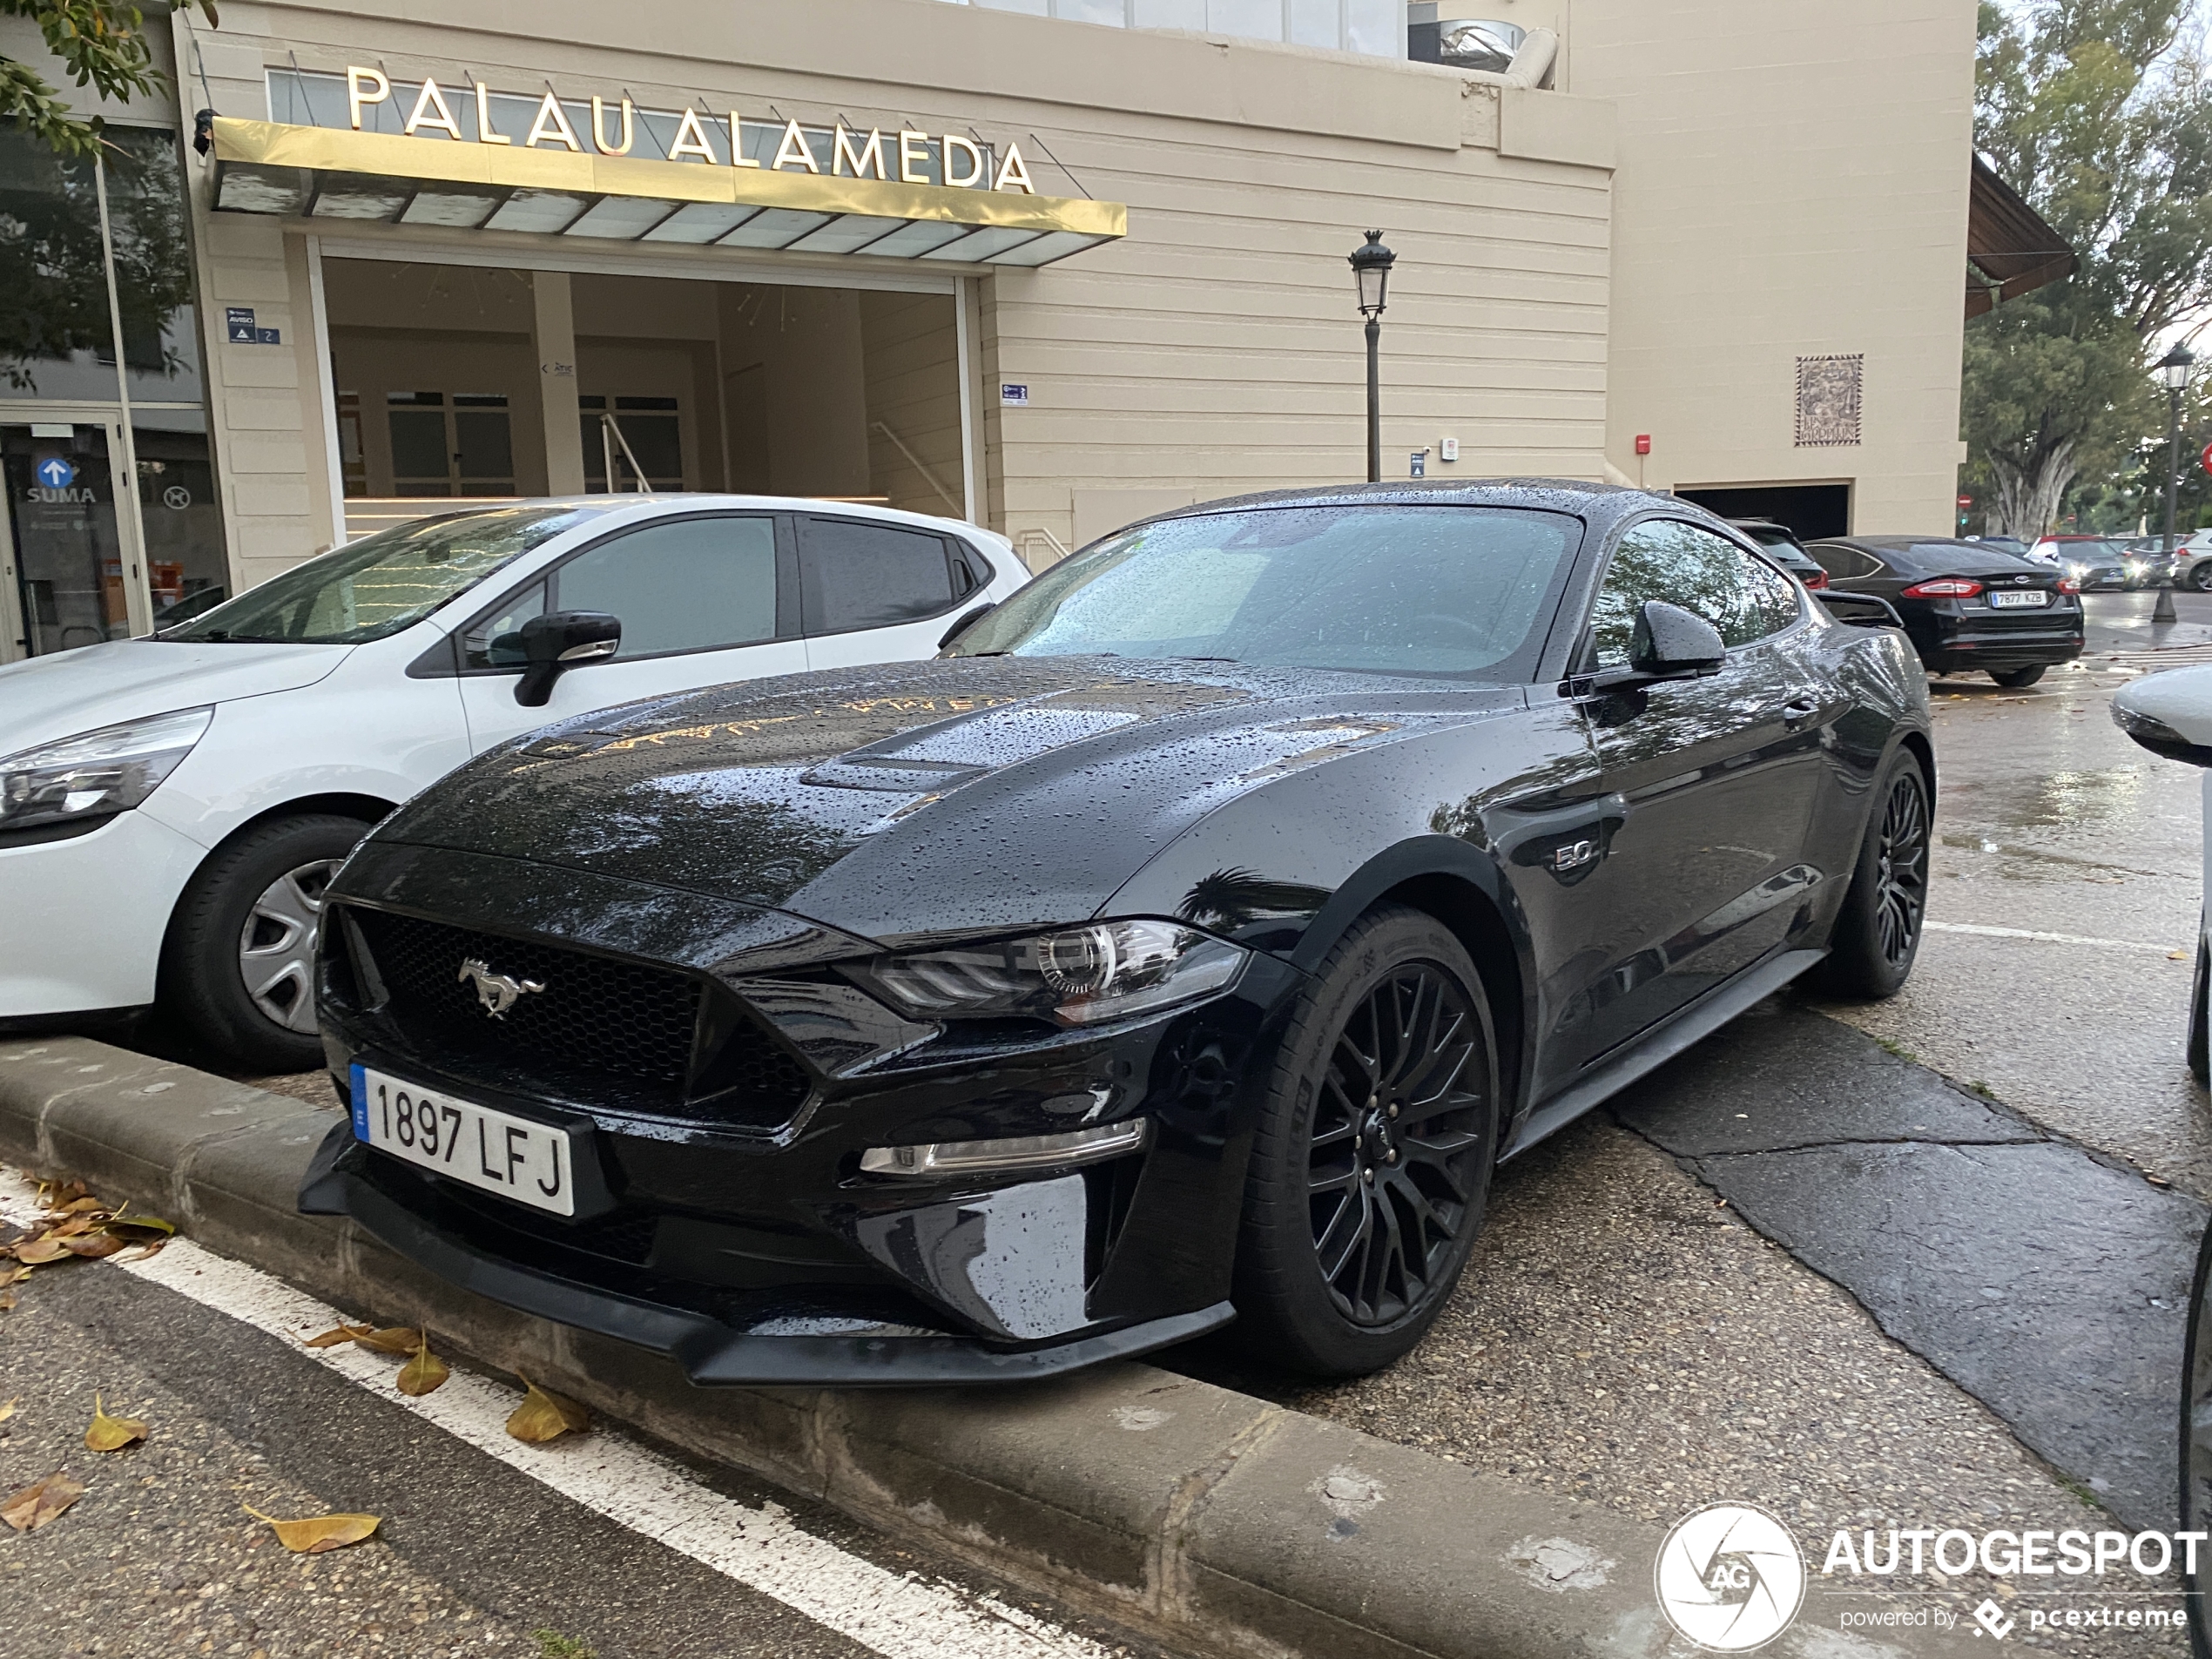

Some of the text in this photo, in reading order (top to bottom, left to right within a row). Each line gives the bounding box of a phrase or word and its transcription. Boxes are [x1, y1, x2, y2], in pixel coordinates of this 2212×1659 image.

[347, 65, 1035, 193] PALAU ALAMEDA
[265, 331, 273, 341] 2
[27, 488, 96, 503] SUMA
[1999, 592, 2041, 604] 7877 KZB
[378, 1084, 560, 1197] 1897 LFJ
